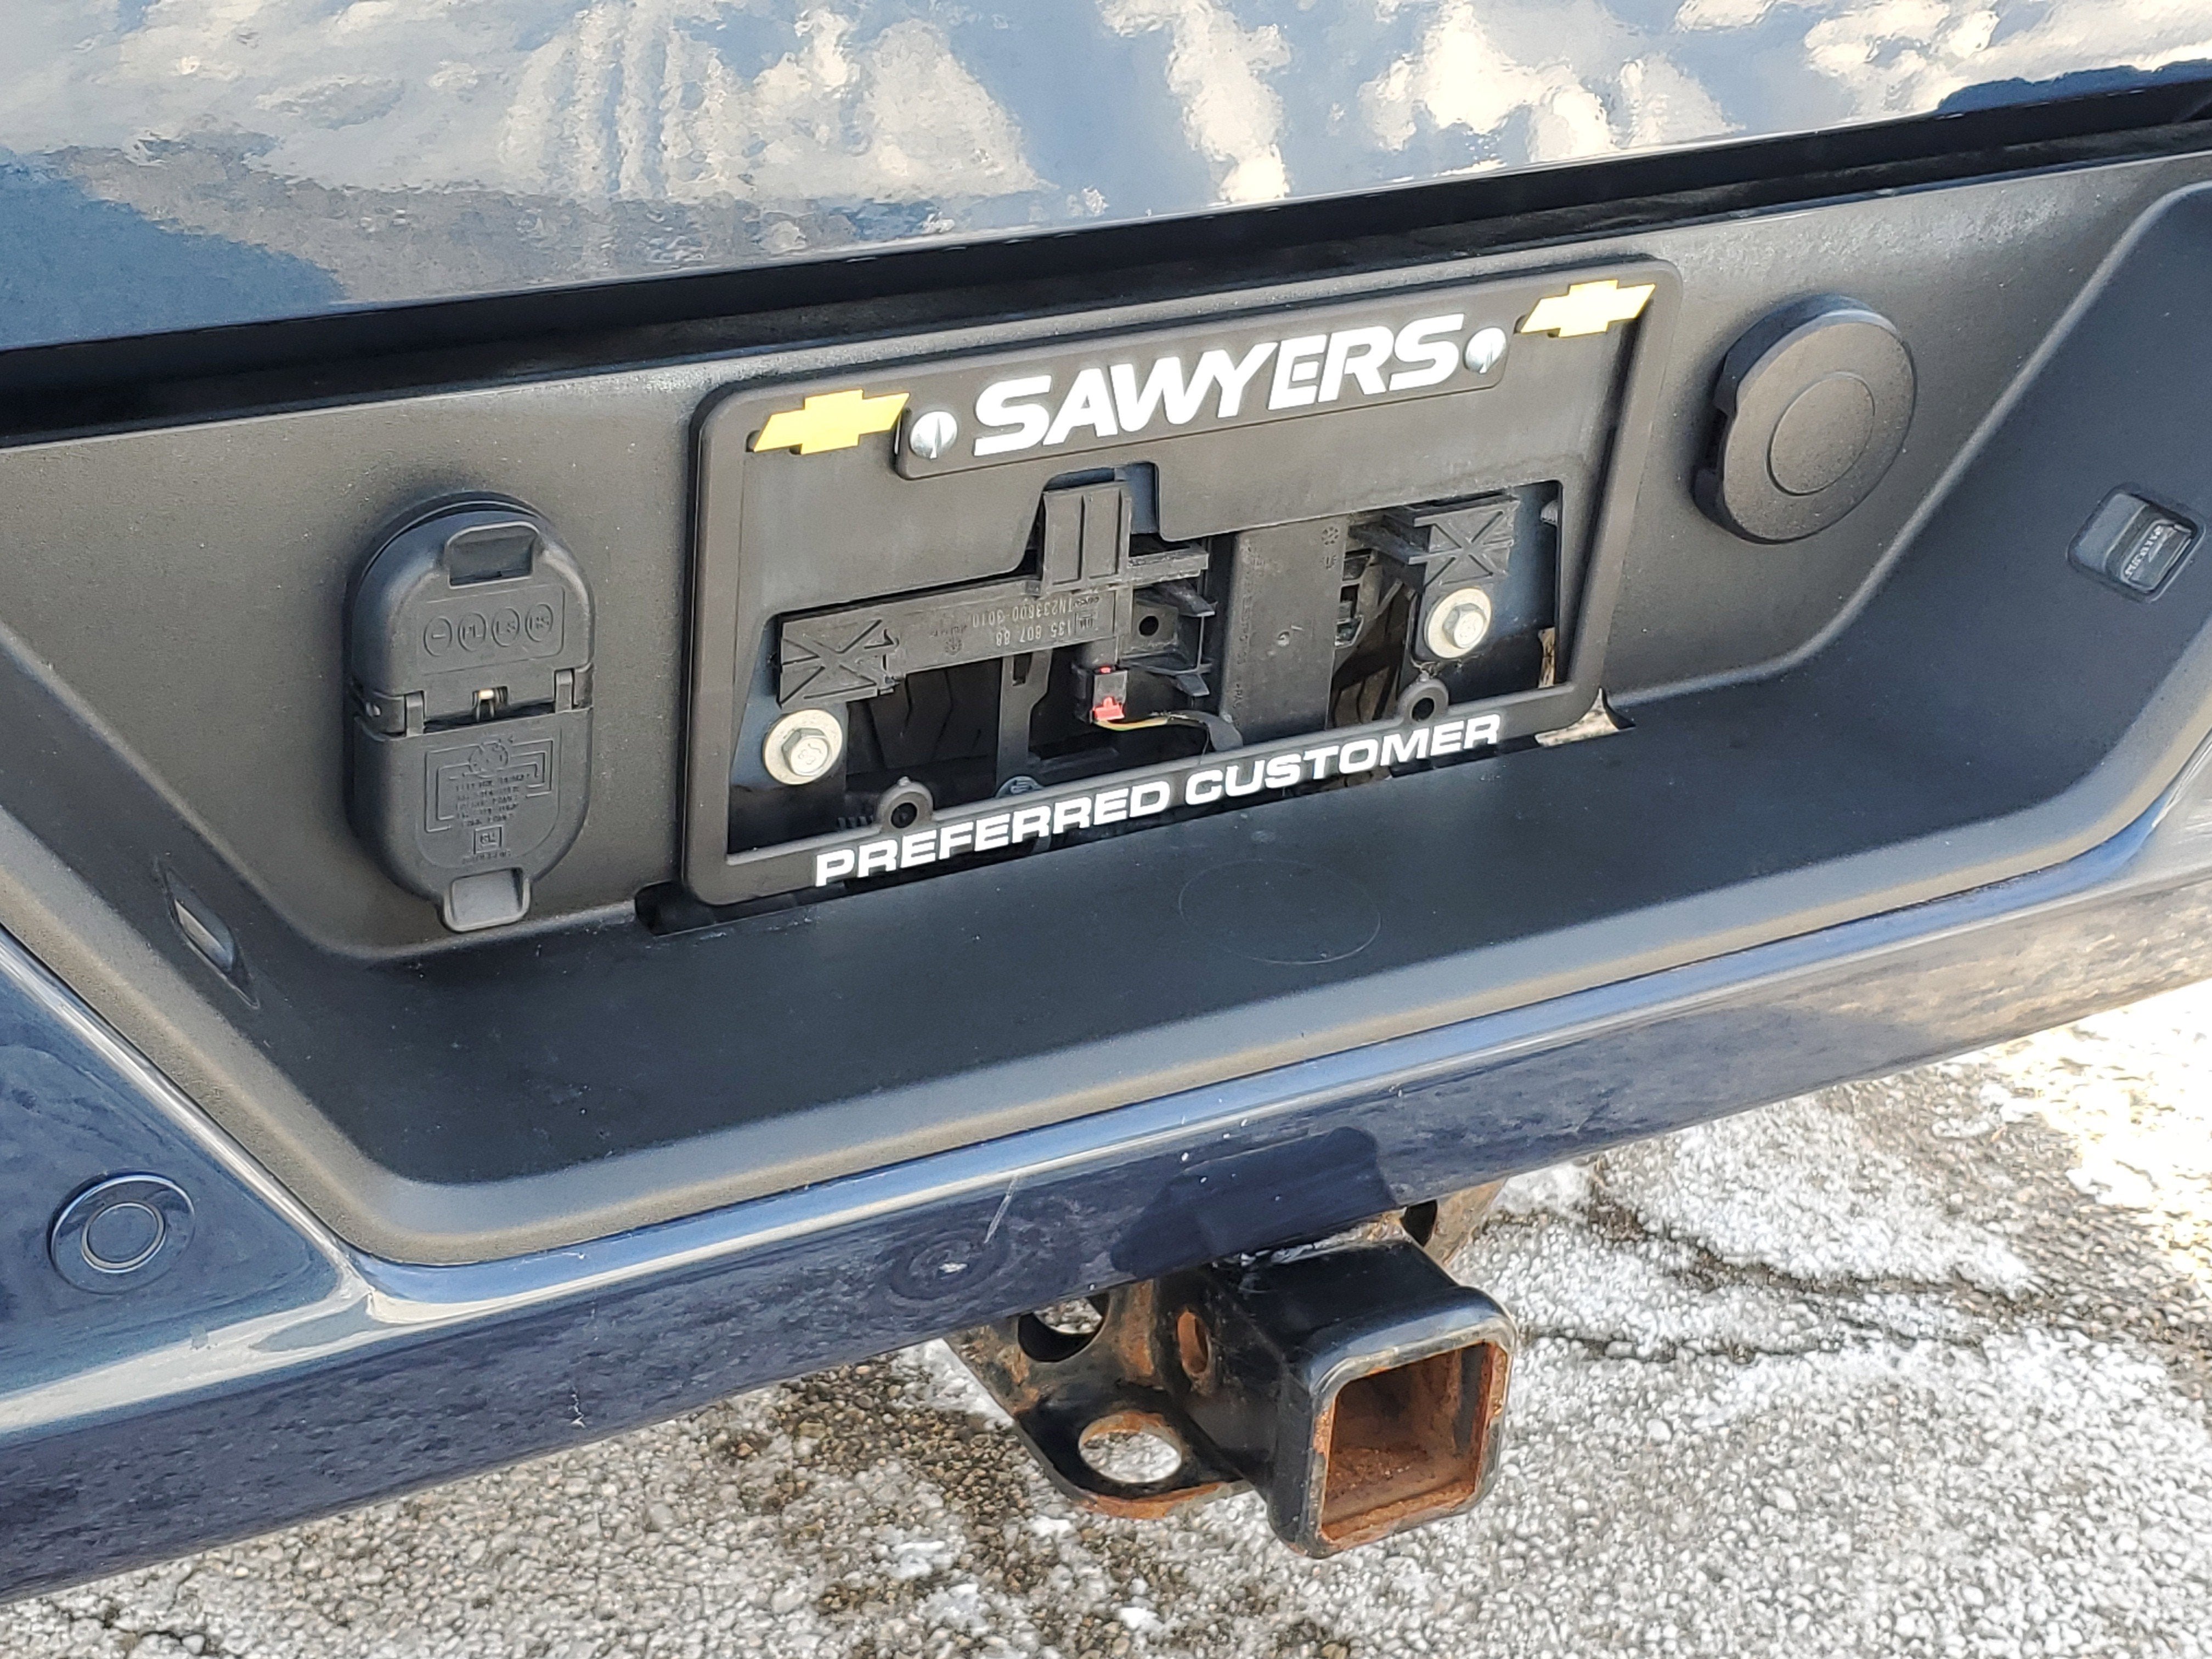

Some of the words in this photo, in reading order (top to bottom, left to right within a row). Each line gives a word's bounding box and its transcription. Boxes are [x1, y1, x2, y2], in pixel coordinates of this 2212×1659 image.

[973, 313, 1465, 457] SAWYERS
[814, 780, 1172, 888] PREFERRED
[1184, 713, 1502, 805] CUSTOMER
